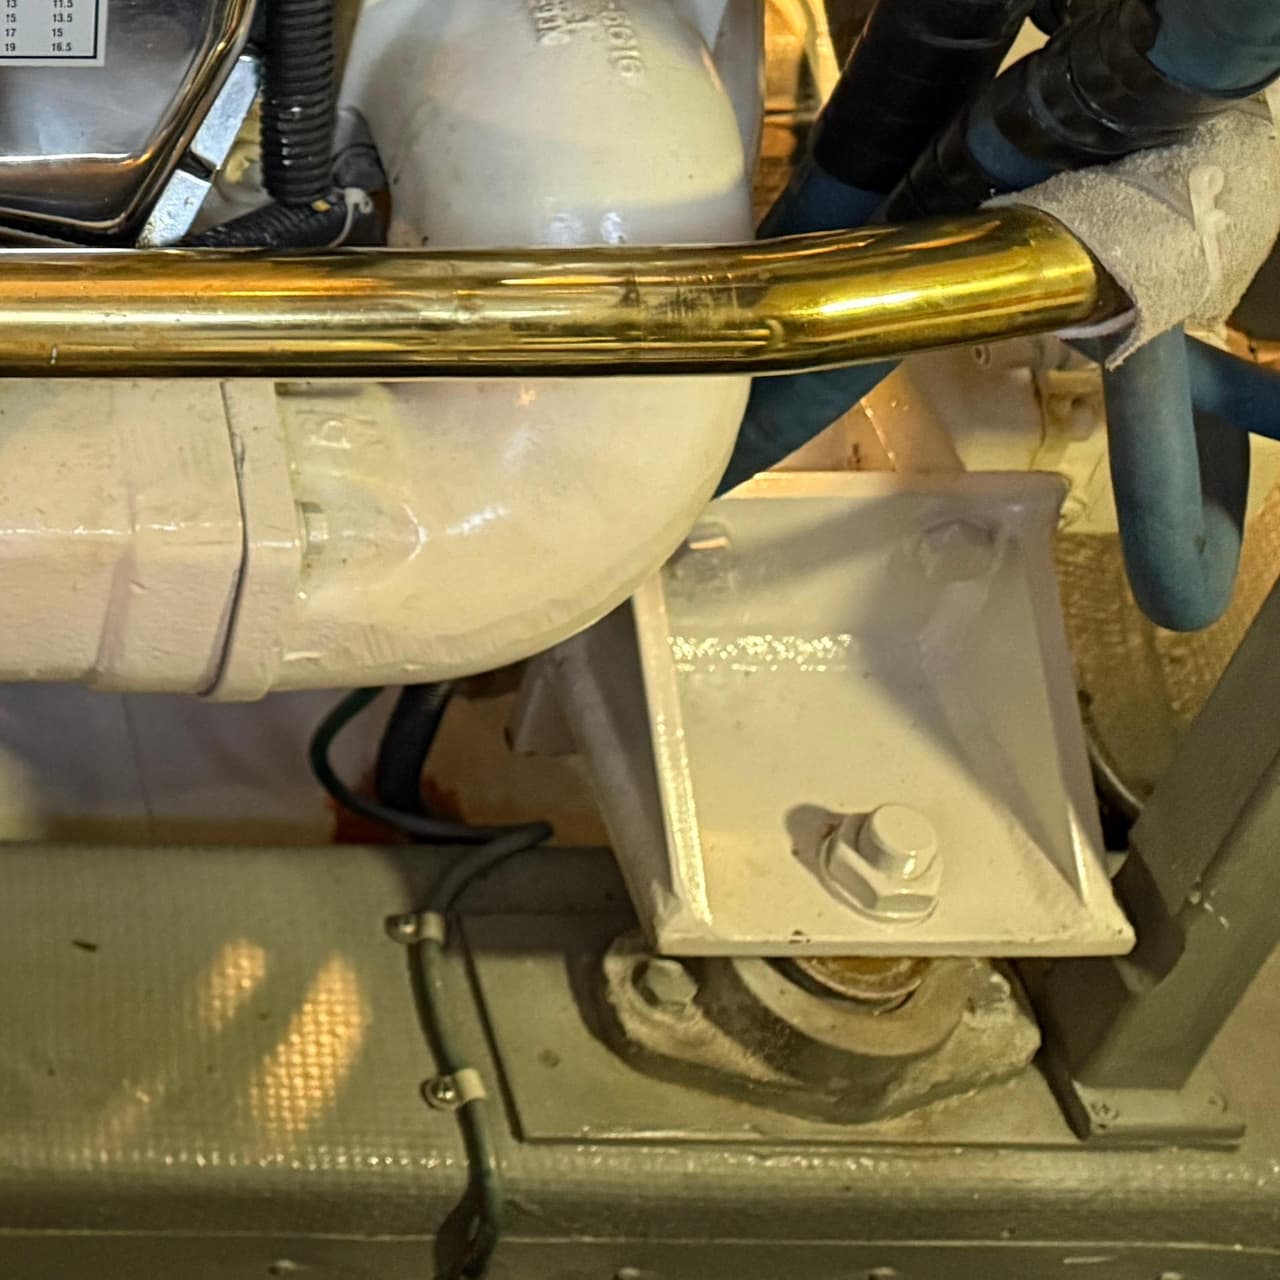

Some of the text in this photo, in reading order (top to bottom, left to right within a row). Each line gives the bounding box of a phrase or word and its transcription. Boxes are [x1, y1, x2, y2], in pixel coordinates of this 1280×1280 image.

[6, 0, 17, 9] 13
[53, 0, 74, 9] 11.5
[5, 13, 17, 23] 15
[52, 13, 73, 23] 13.5
[5, 28, 16, 38] 17
[52, 28, 63, 38] 15
[4, 42, 16, 52] 19
